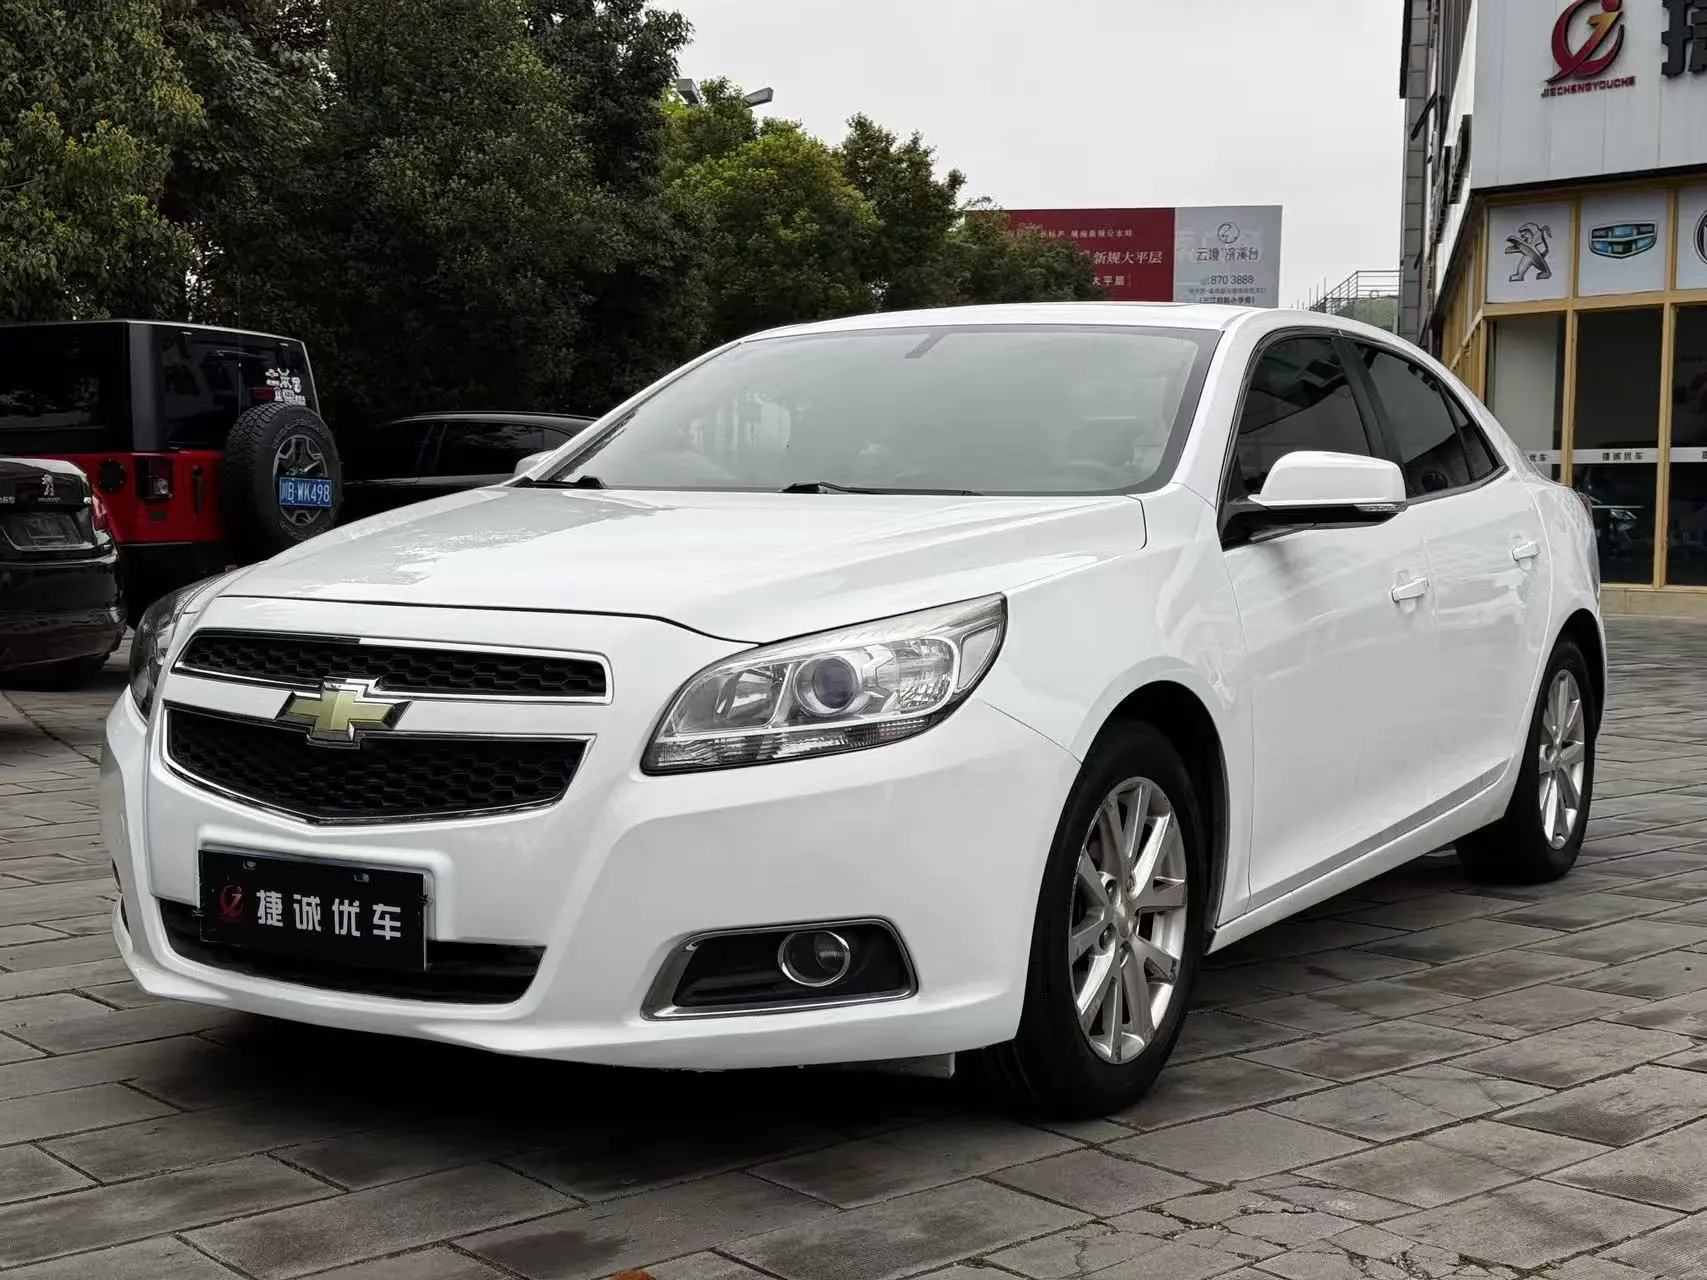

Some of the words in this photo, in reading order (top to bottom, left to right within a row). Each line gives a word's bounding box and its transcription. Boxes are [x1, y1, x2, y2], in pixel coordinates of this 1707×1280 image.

[1093, 251, 1162, 265] 新规大平层
[256, 889, 402, 941] 捷诚优车
